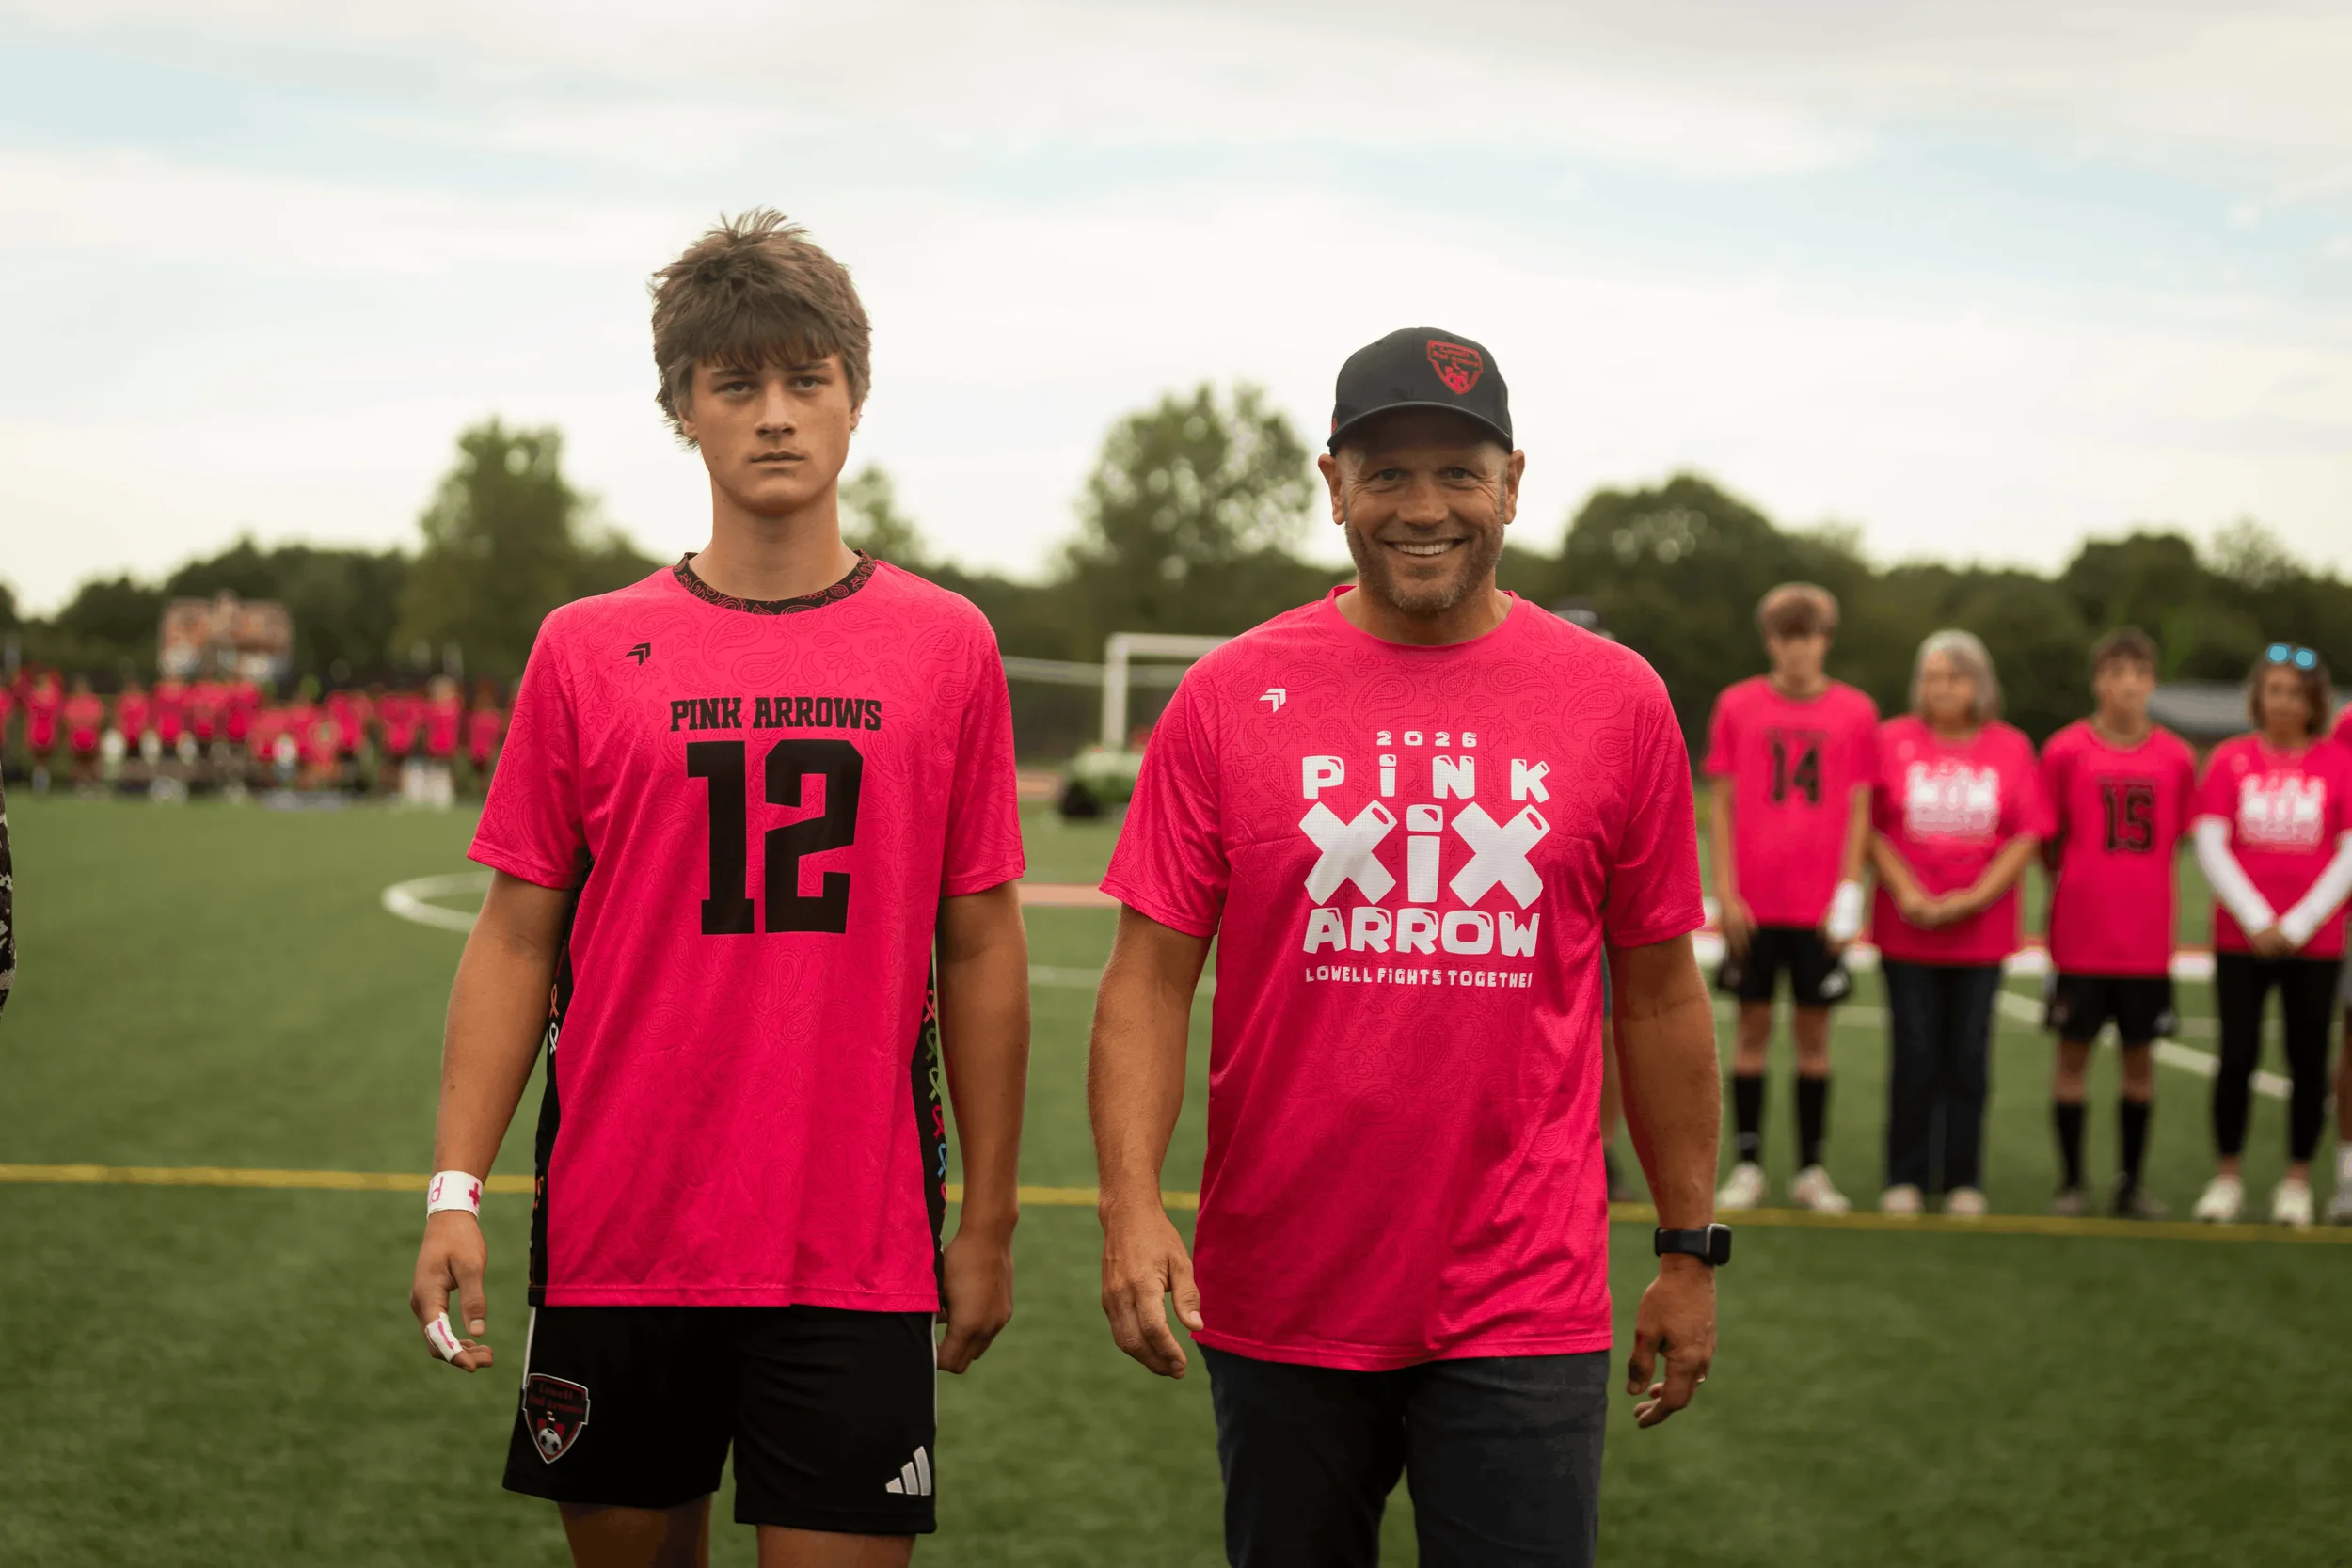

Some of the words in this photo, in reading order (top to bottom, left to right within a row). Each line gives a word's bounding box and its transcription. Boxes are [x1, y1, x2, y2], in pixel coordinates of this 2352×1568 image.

[672, 698, 741, 731] PINK
[754, 698, 881, 730] ARROWS
[1377, 731, 1476, 747] 2026
[1771, 739, 1820, 804] 14
[687, 739, 863, 935] 12
[2104, 787, 2153, 852] 15
[1302, 906, 1541, 958] ARROW
[1307, 966, 1372, 982] LOWELL
